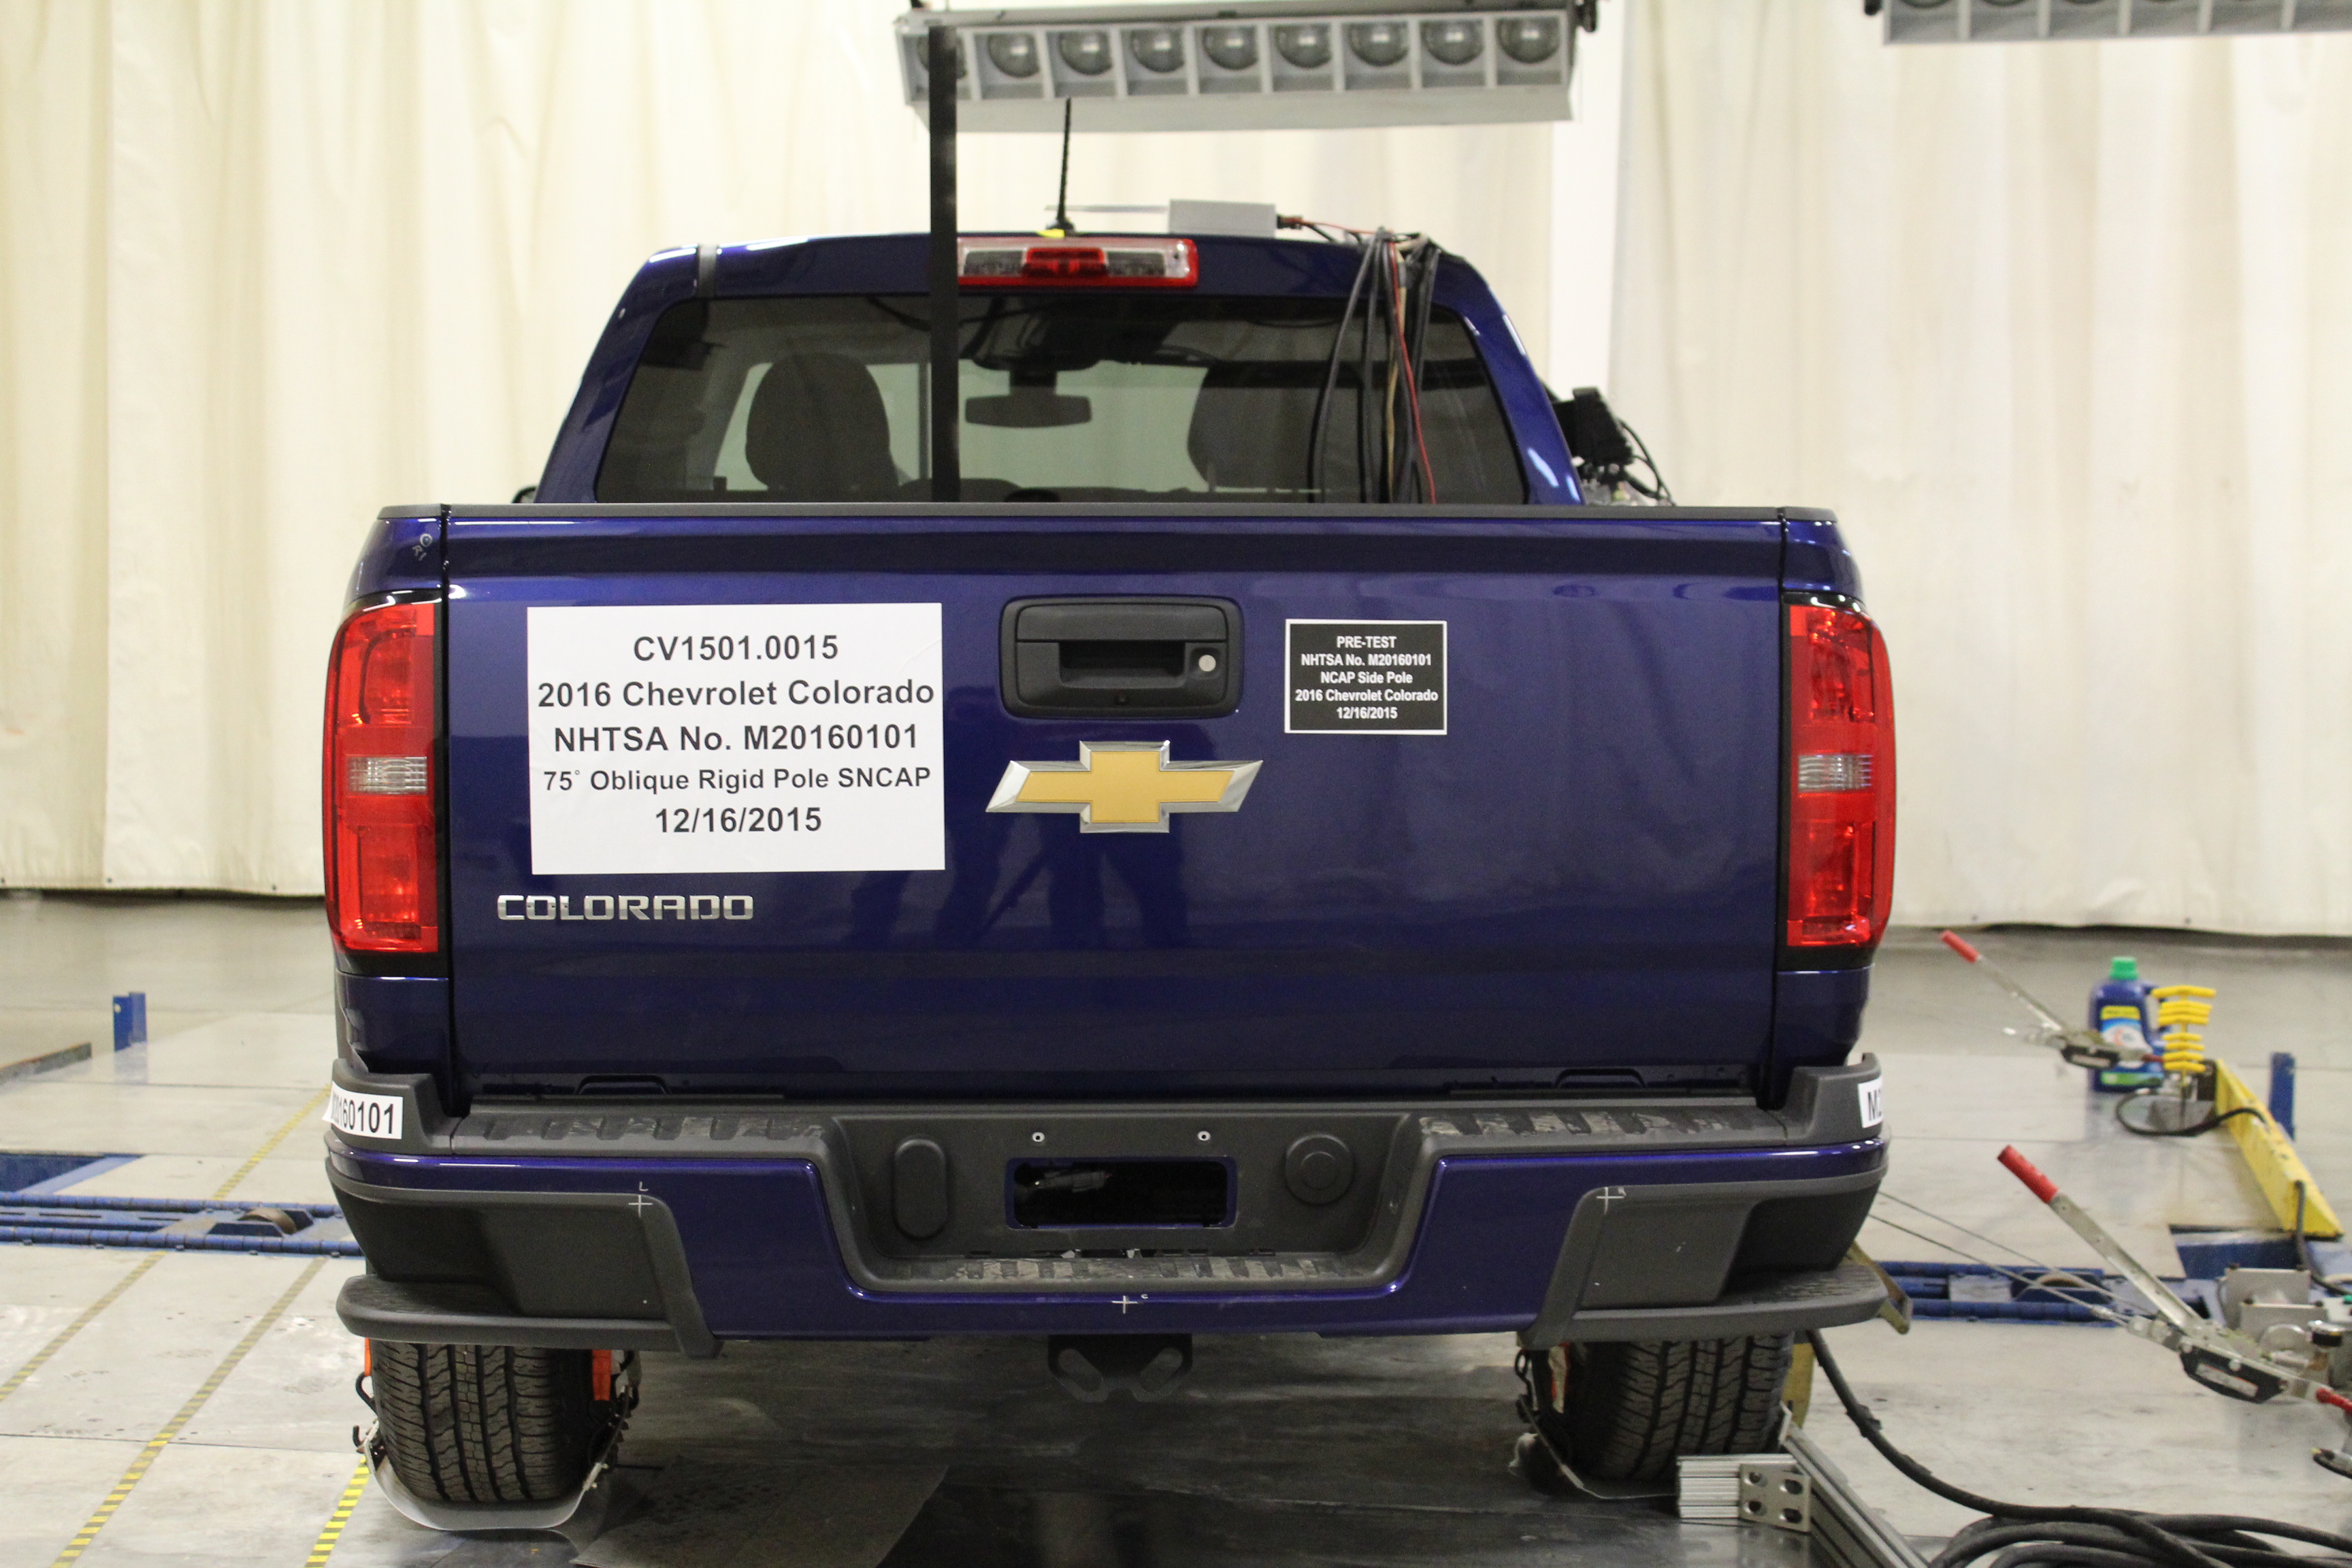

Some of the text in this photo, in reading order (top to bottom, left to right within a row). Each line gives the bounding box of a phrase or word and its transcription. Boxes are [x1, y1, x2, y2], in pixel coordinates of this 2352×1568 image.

[634, 634, 838, 662] CV1501.0015
[1336, 635, 1397, 649] PRE-TEST
[1301, 653, 1431, 666] NHTSA No. M20160101
[1320, 670, 1414, 684] NCAP Side Pole
[538, 679, 934, 707] 2016 Chevrolet Colorado
[1294, 688, 1439, 702] 2016 Chevrolet Colorado
[1336, 706, 1398, 719] 12/16/2015
[555, 723, 916, 752] NHTSA No. M20160101
[590, 770, 689, 795] Oblique
[699, 768, 764, 794] Rigid
[774, 768, 829, 788] Pole
[838, 767, 931, 788] SNCAP
[655, 806, 822, 833] 12/16/2015
[497, 895, 754, 921] COLORADO
